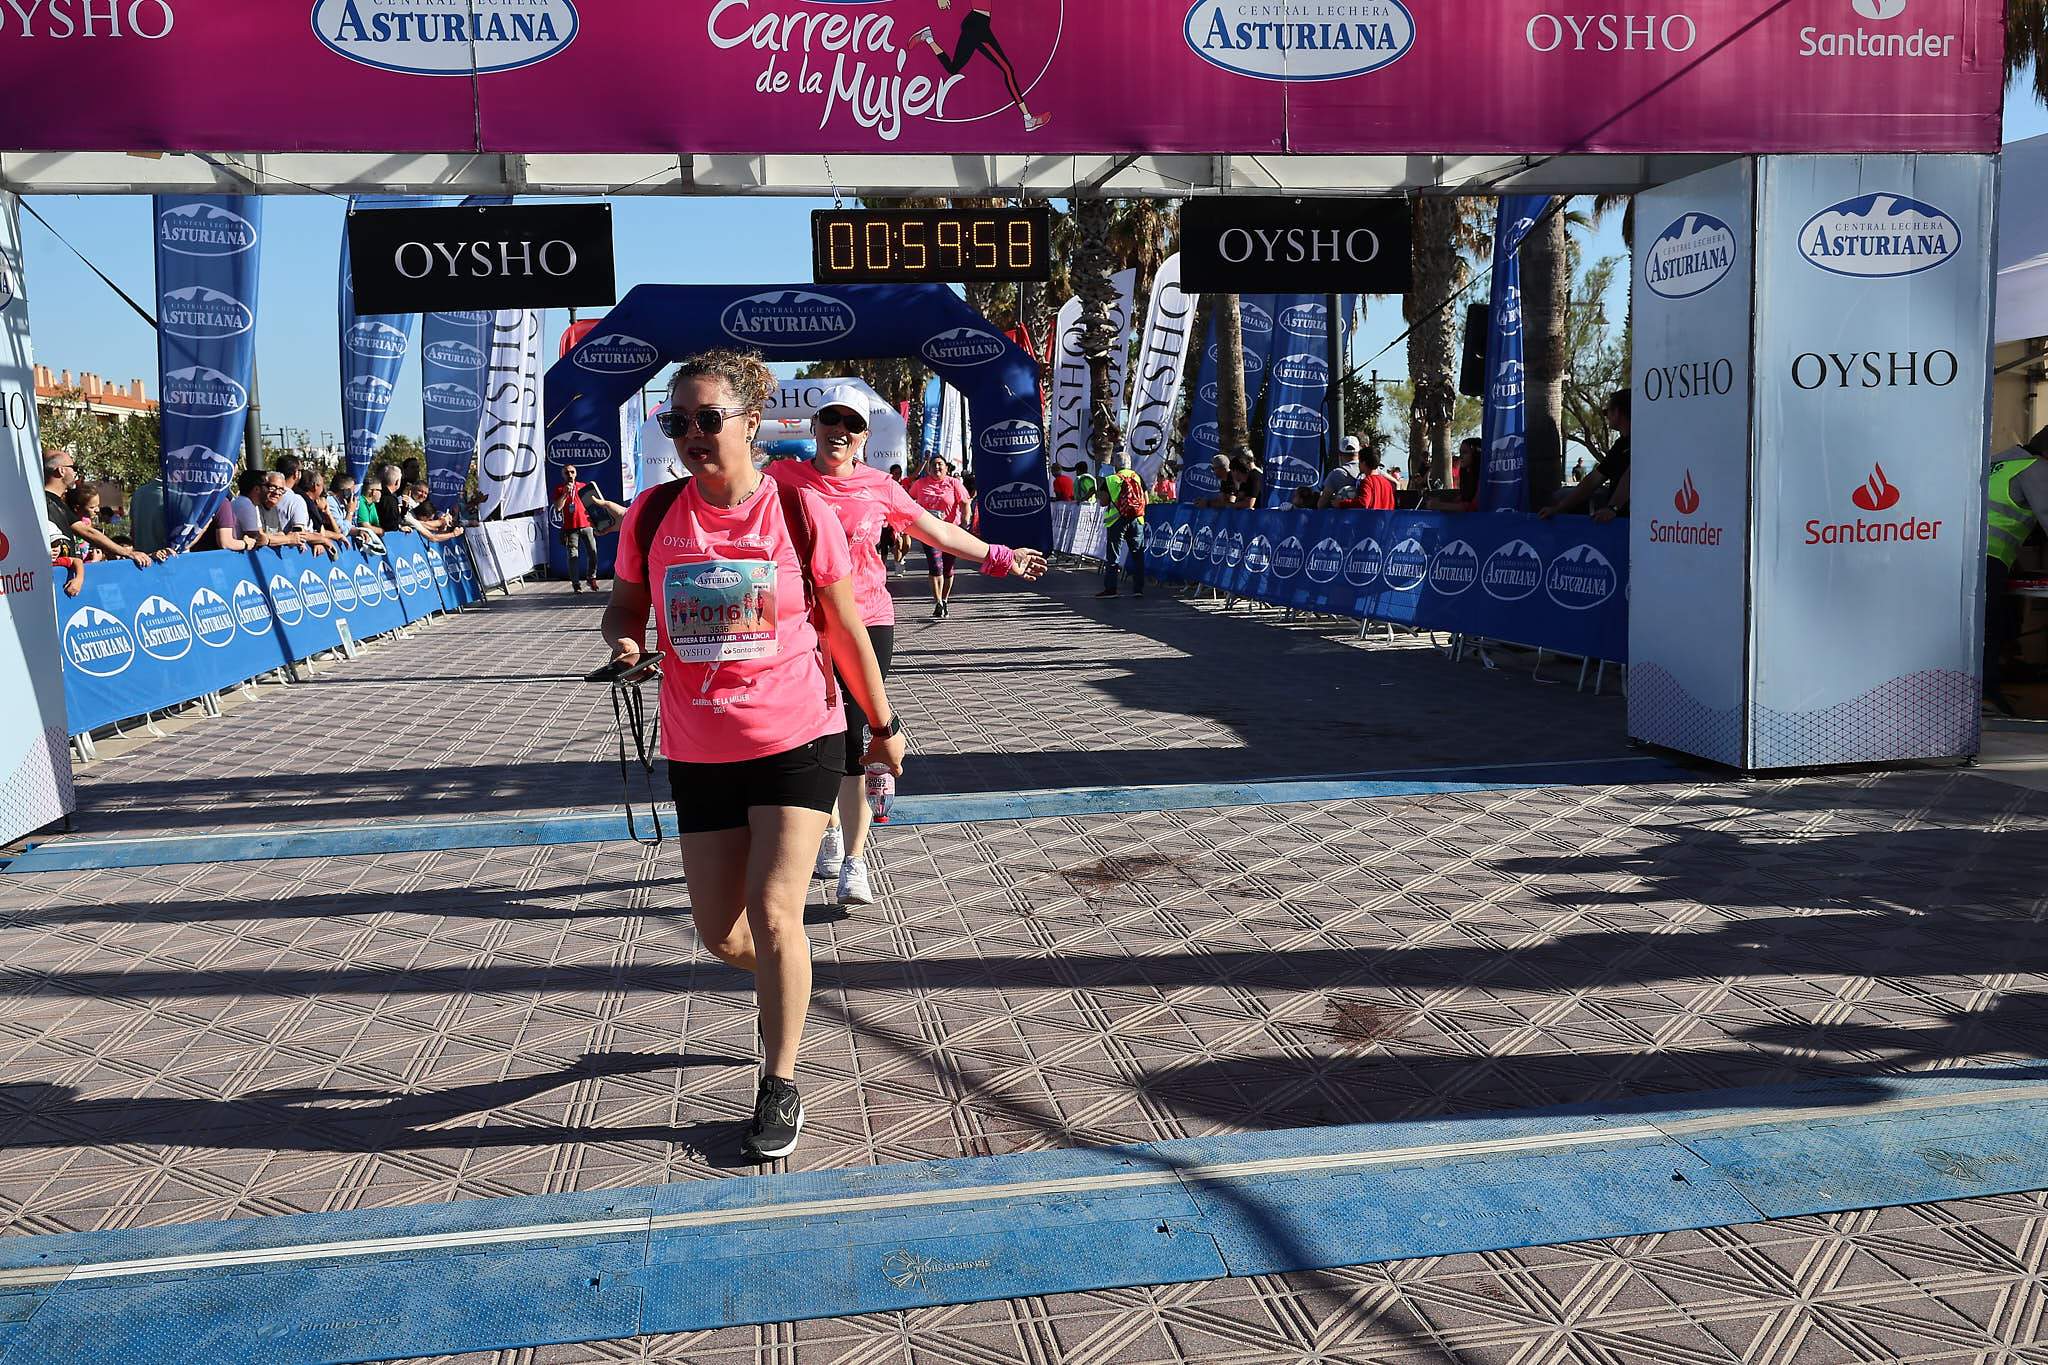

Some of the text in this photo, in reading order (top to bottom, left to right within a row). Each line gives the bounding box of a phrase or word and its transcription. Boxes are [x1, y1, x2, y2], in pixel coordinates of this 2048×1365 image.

[0, 0, 174, 39] YSHO
[334, 0, 559, 42] ASTURIANA
[1238, 5, 1389, 16] CENTRAL LECHERA
[707, 0, 900, 52] Carrera
[1203, 7, 1397, 50] ASTURIANA
[1526, 14, 1697, 53] OYSHO
[1800, 26, 1955, 58] Santander
[755, 49, 965, 141] de la Mujer
[162, 220, 247, 245] ASTURIANA
[1835, 221, 1944, 231] CENTRAL LECHERA
[829, 221, 1032, 270] 00:59:58
[1218, 227, 1380, 263] OYSHO
[1810, 225, 1948, 257] ASTURIANA
[394, 239, 578, 279] OYSHO
[1650, 245, 1729, 283] ASTURIANA
[731, 308, 847, 332] ASTURIANA
[798, 305, 841, 313] LECHERA
[1283, 313, 1327, 330] ASTURIA
[428, 346, 482, 366] ASTURIANA
[578, 349, 652, 364] ASTURIANA
[928, 344, 1000, 358] ASTURIANA
[1131, 282, 1191, 456] OYSHO
[1644, 358, 1733, 401] OYSHO
[1791, 349, 1958, 390] OYSHO
[165, 388, 238, 408] STURIANA
[423, 389, 477, 408] ASTURIANA
[429, 438, 471, 449] STURIANA
[550, 445, 607, 458] ASTURIANA
[984, 434, 1040, 448] ASTURIANA
[989, 496, 1044, 510] ASTURIANA
[1650, 519, 1723, 546] Santander
[1805, 517, 1942, 545] Santander
[1386, 555, 1424, 579] ASTURIANA
[1431, 560, 1473, 582] ASTURIANA
[1484, 561, 1536, 587] ASTURIANA
[0, 567, 35, 595] ander
[698, 575, 740, 585] ASTURIANA
[1549, 567, 1606, 596] ASTURIANA
[141, 621, 190, 648] ASTURIANA
[194, 612, 233, 635] ASTURIANA
[70, 635, 132, 663] ASTURIANA
[673, 636, 698, 644] CARRERA
[700, 635, 707, 643] DE
[717, 633, 737, 642] MUJER
[742, 633, 770, 641] VALENCIA
[733, 646, 766, 654] Santander
[680, 648, 711, 658] OYSHO
